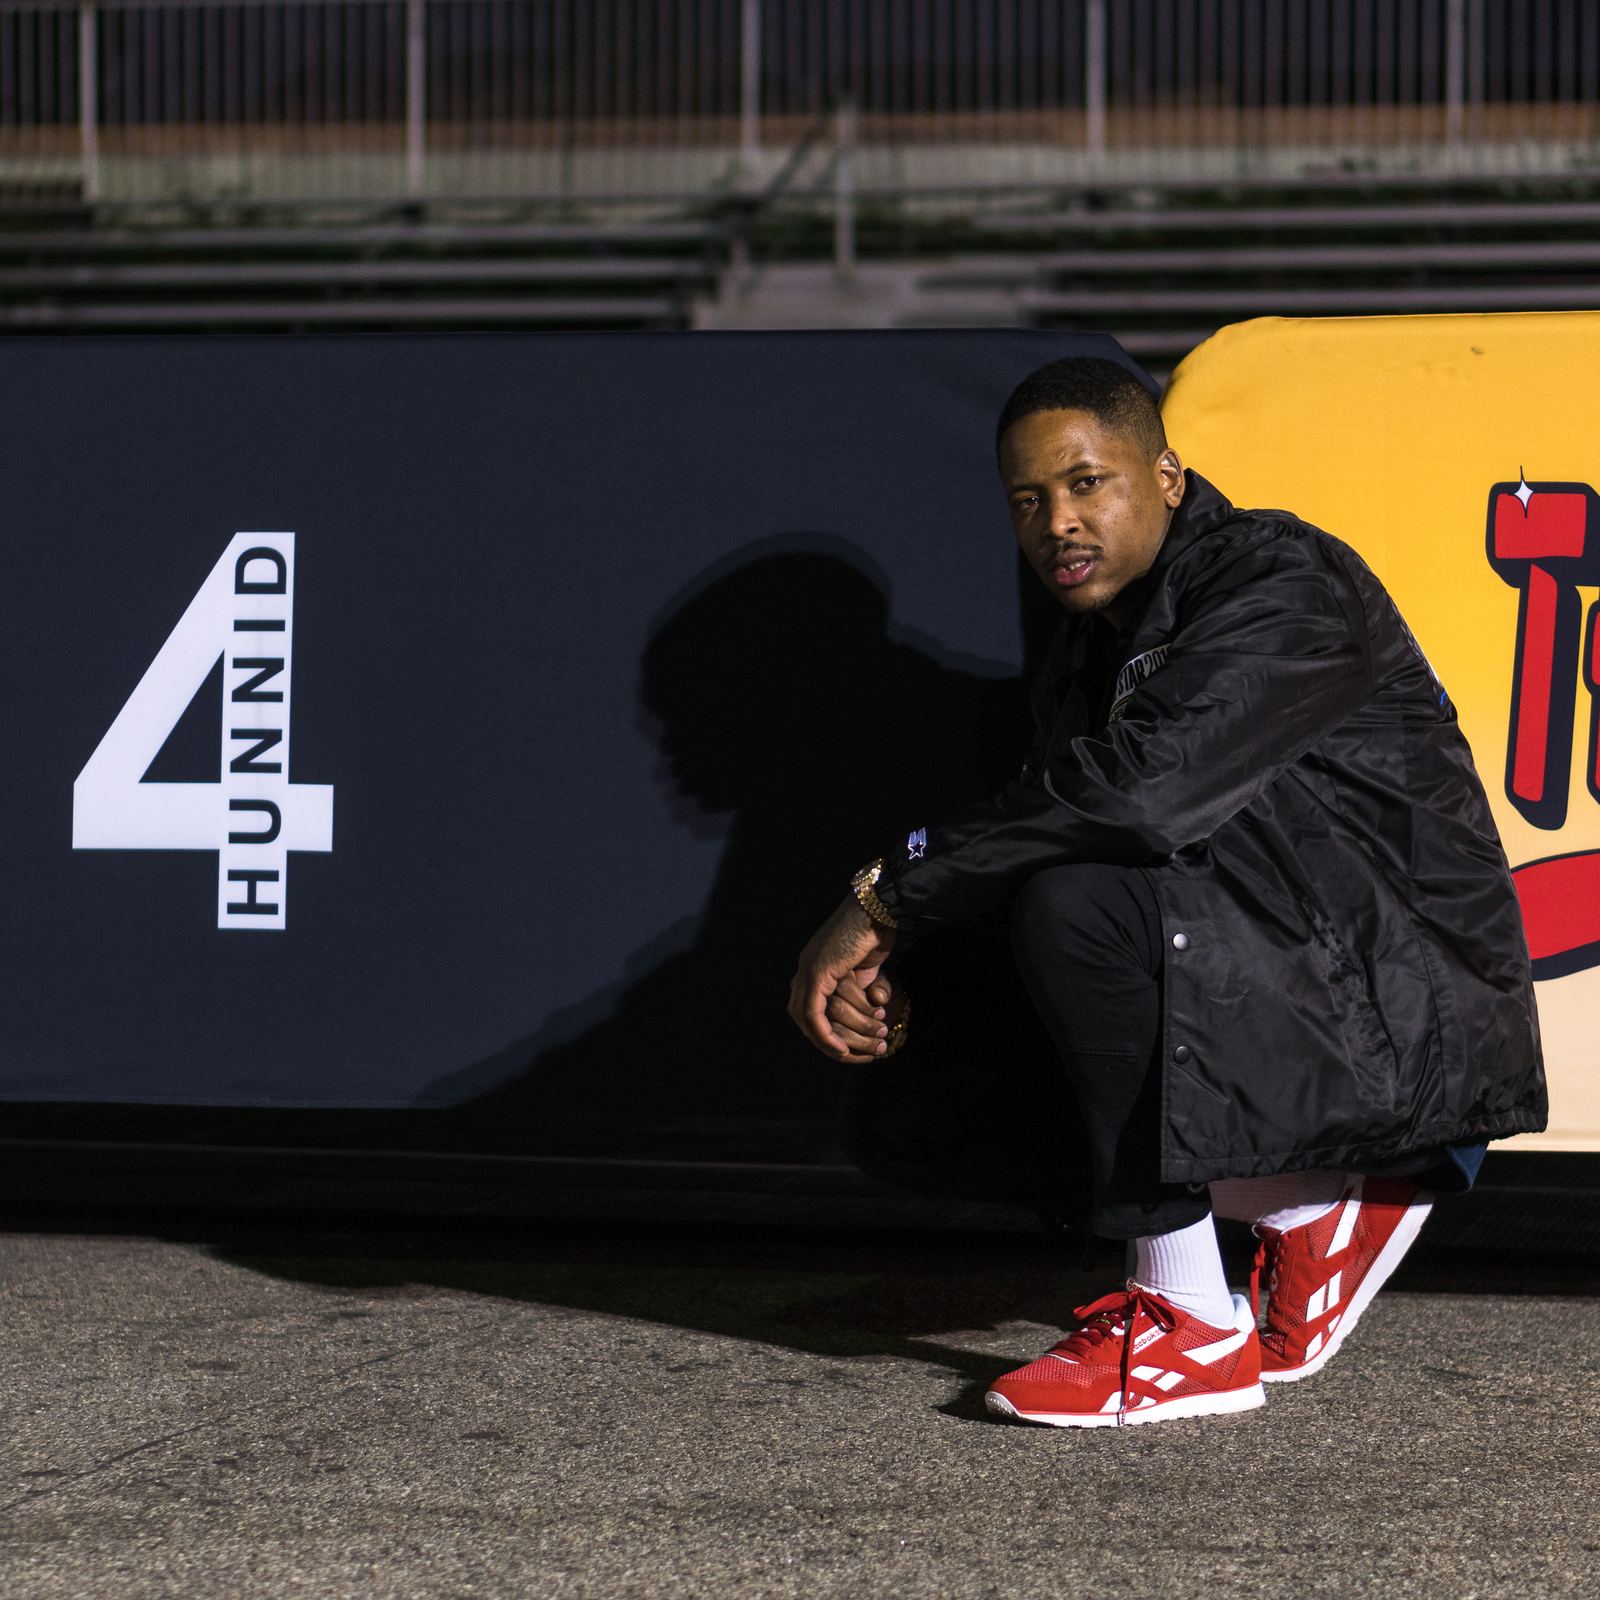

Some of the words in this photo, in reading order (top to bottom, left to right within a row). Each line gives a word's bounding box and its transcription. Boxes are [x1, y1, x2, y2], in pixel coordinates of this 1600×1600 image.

[72, 531, 334, 930] 4
[226, 546, 287, 916] HUNNID
[1485, 481, 1600, 830] T
[1133, 1332, 1156, 1351] eebok
